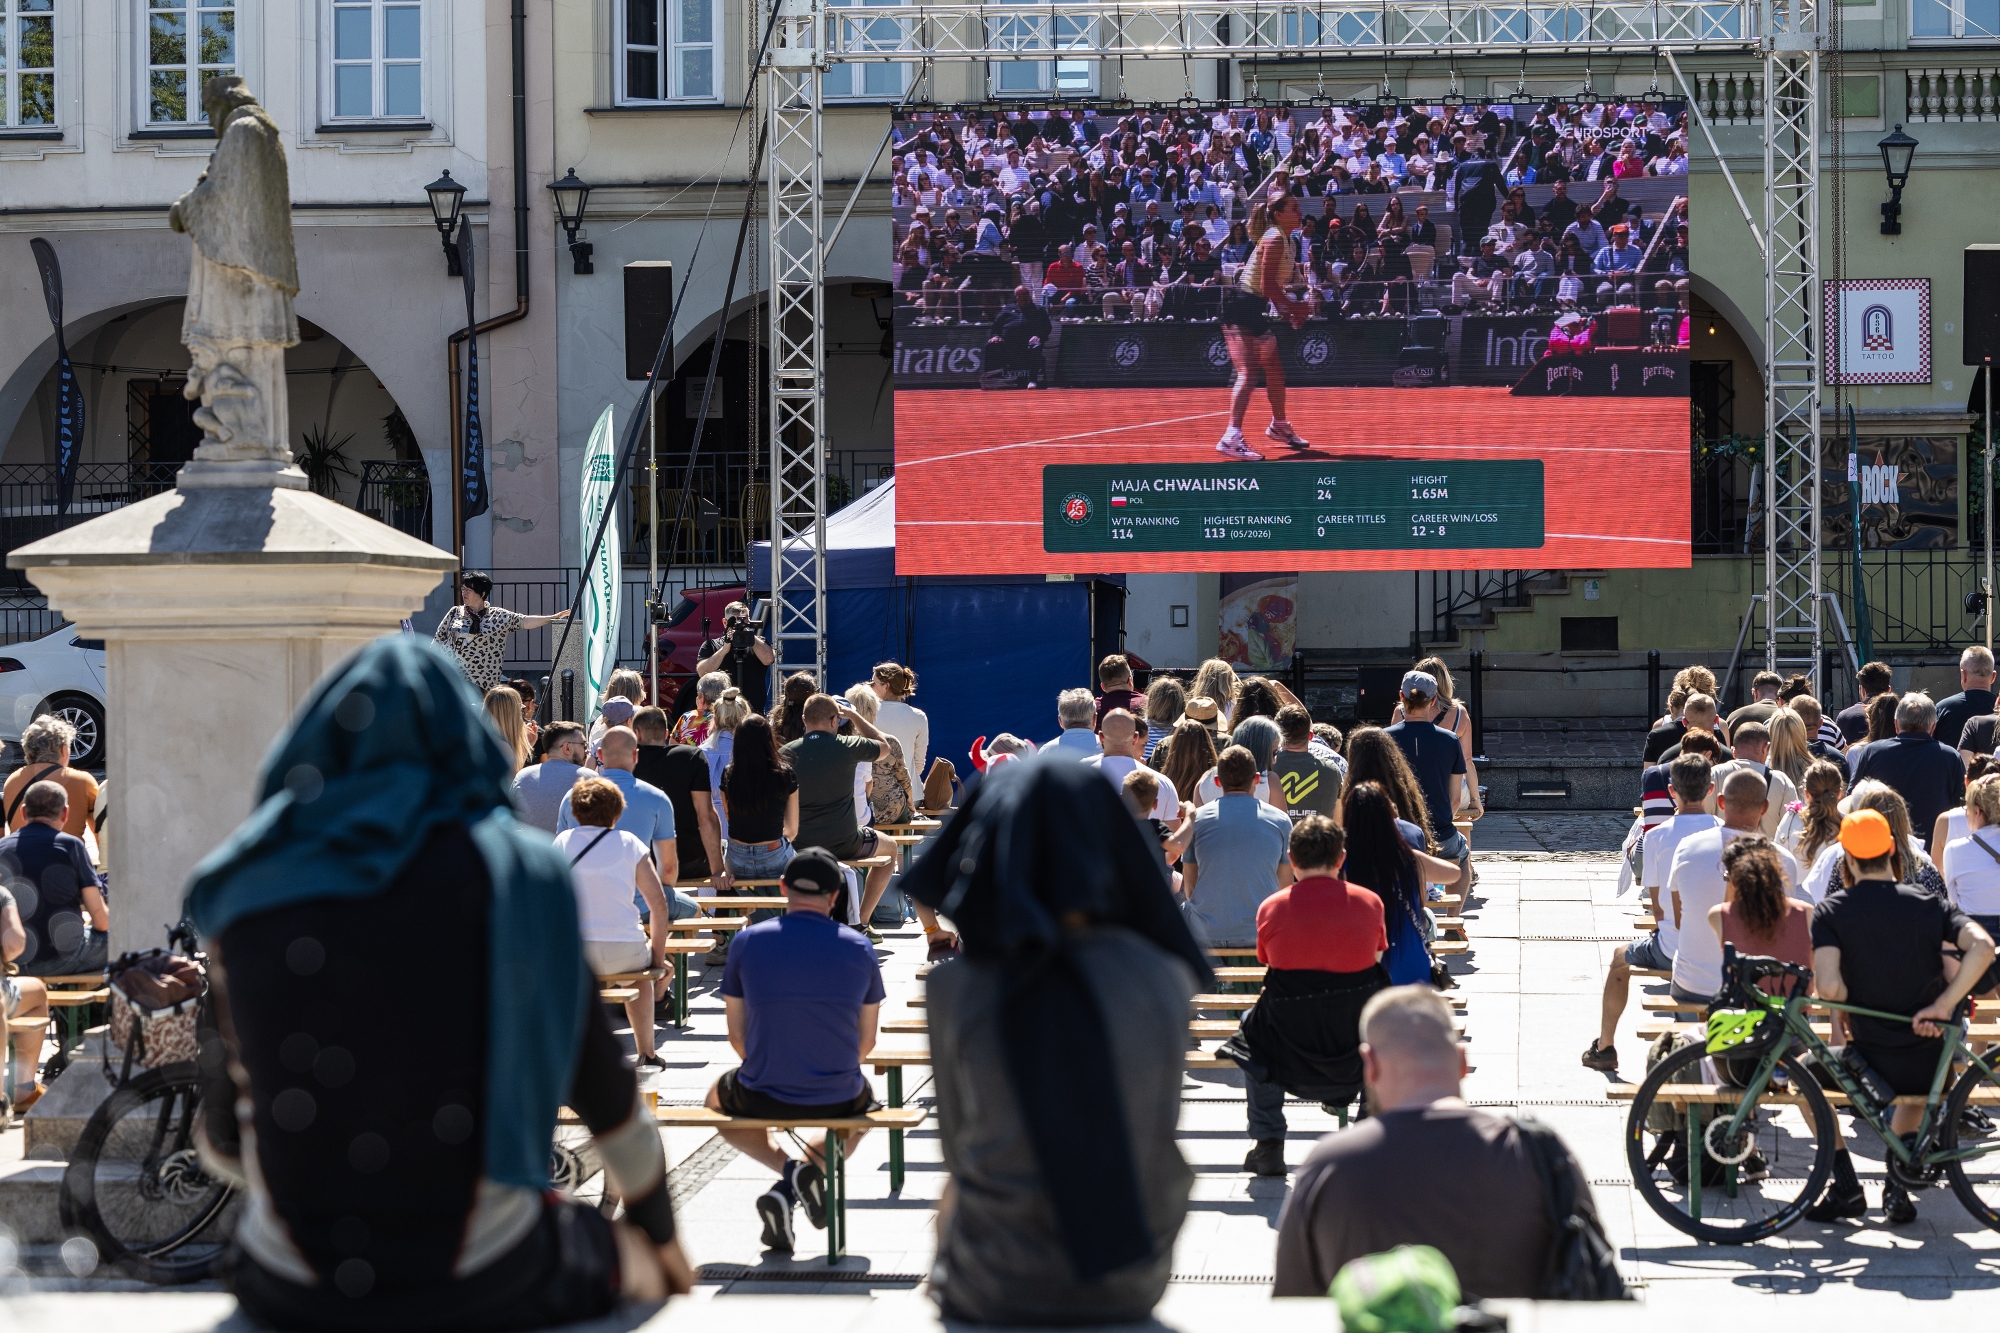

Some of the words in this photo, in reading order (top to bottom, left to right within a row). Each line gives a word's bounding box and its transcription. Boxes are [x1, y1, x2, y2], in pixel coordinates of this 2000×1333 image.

[1564, 127, 1648, 138] EUROSPORT
[1546, 363, 1584, 391] perrier
[1642, 363, 1676, 387] perrier
[1111, 479, 1150, 492] MAJA
[1153, 478, 1260, 492] CHWALINSKA
[1317, 476, 1337, 486] AGE
[1411, 475, 1448, 485] HEIGHT
[1861, 465, 1900, 504] ROCK
[1317, 489, 1332, 500] 24
[1411, 488, 1449, 499] 1.65M
[1129, 497, 1144, 505] POL
[1111, 517, 1134, 526] WTA
[1135, 516, 1180, 526] RANKING
[1204, 516, 1246, 525] HIGHEST
[1247, 515, 1292, 525] RANKING
[1317, 514, 1355, 524] CAREER
[1355, 514, 1386, 524] TITLES
[1411, 514, 1448, 523] CAREER
[1449, 513, 1498, 523] WIN/LOSS
[1111, 528, 1134, 539] 114
[1204, 527, 1226, 539] 113
[1230, 529, 1271, 540] (05/2026)
[1317, 526, 1325, 537] 0
[1411, 525, 1427, 536] 12
[1438, 525, 1446, 536] 8
[1287, 809, 1318, 817] BLIFE
